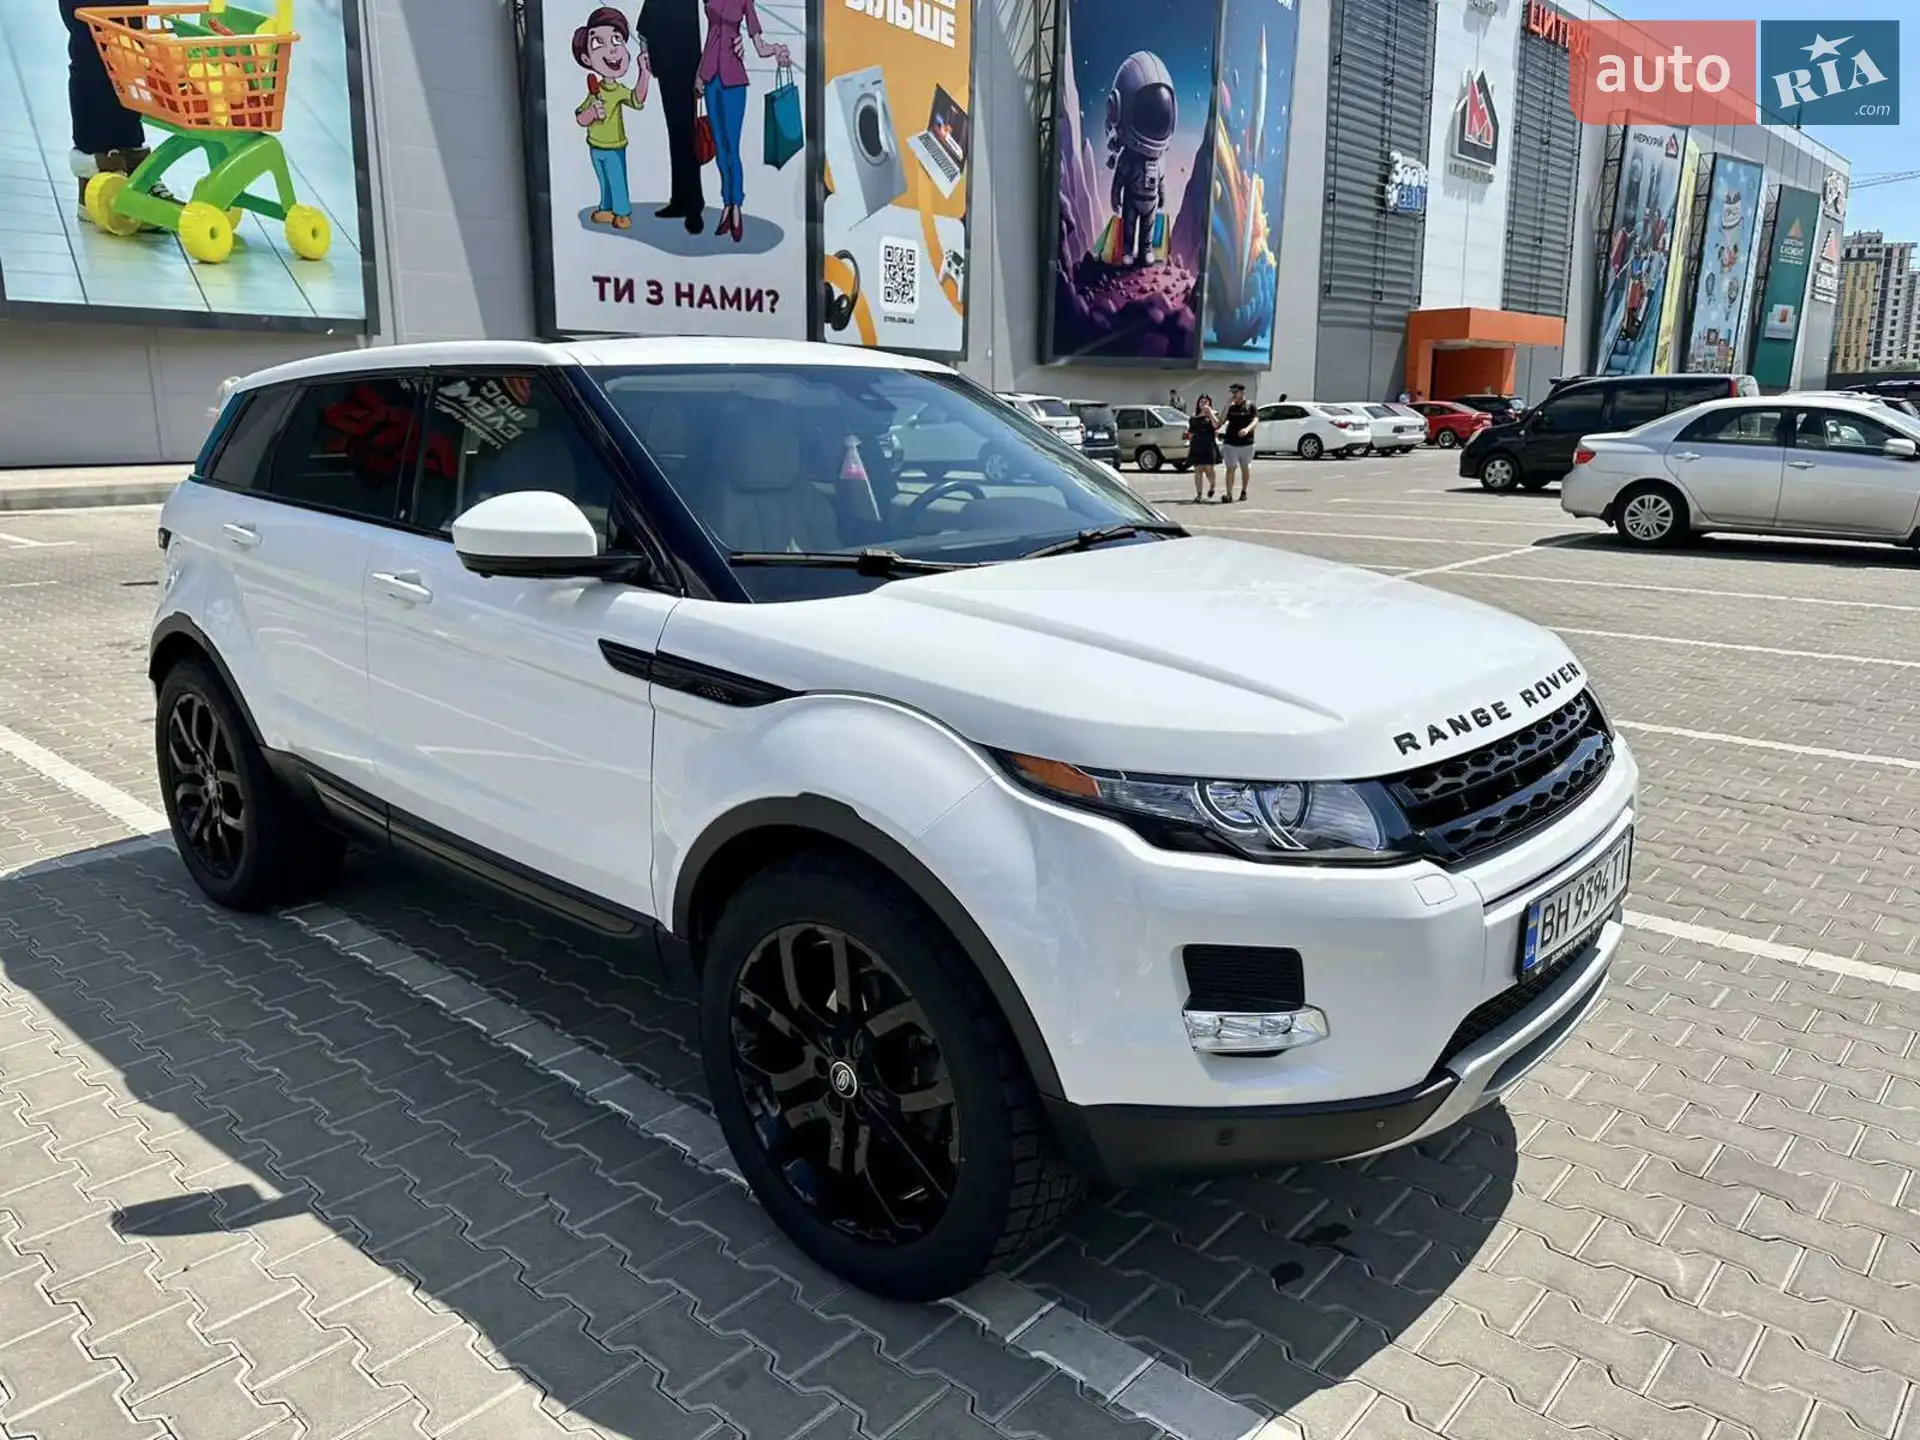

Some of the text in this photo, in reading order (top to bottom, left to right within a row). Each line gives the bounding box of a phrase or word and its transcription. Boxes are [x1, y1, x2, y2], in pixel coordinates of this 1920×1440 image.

[592, 275, 780, 314] ТИ З НАМИ?
[1393, 661, 1581, 755] RANGE ROVER
[1541, 891, 1571, 948] BH
[1572, 861, 1610, 929] 9394
